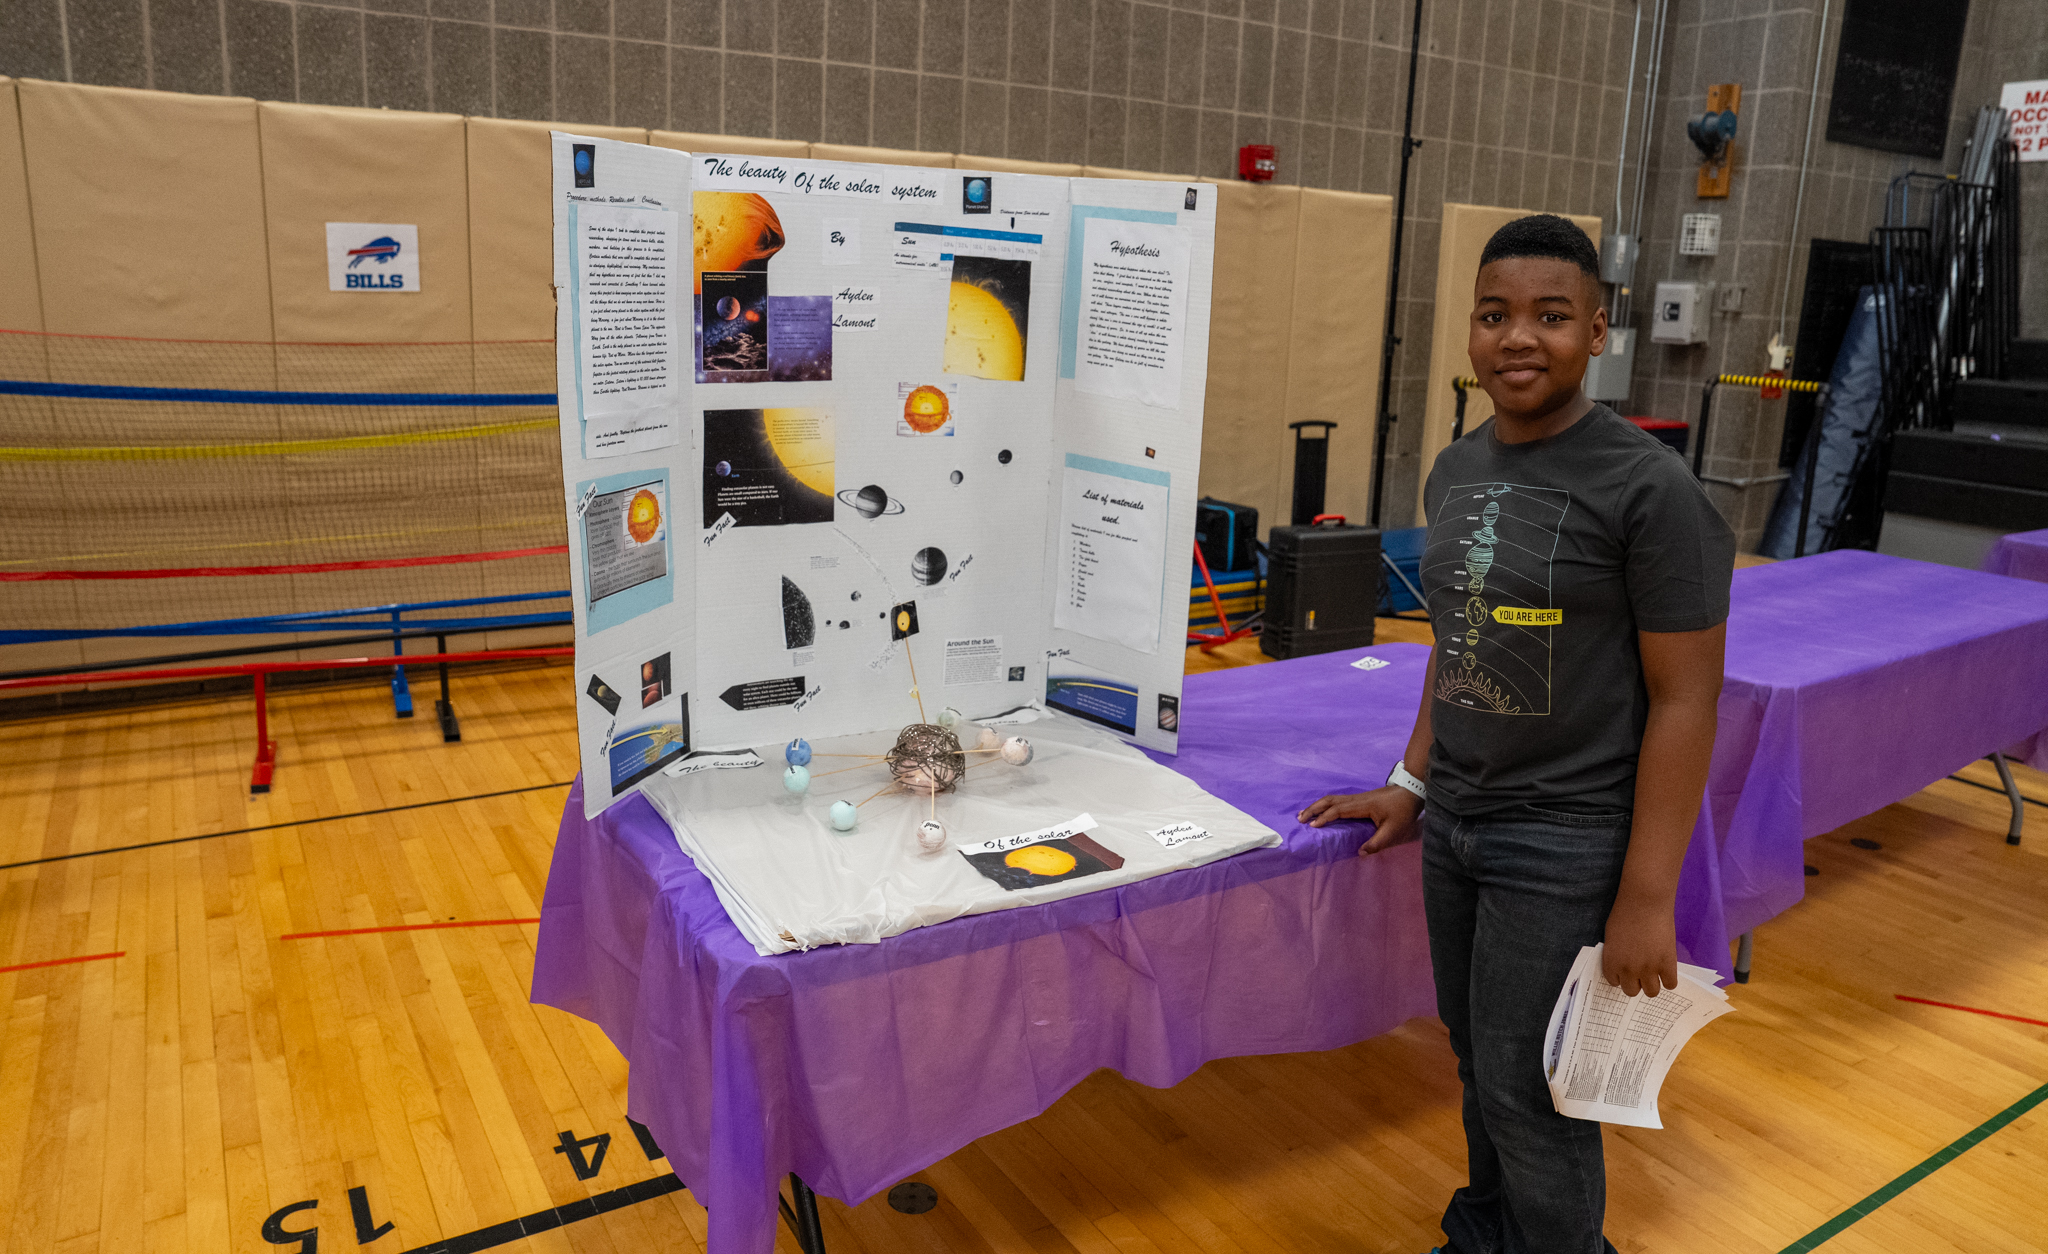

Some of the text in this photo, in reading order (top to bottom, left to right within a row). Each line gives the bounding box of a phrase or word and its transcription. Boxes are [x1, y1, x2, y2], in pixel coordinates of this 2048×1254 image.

[704, 158, 937, 200] The beauty Of the solar system
[830, 232, 845, 246] By
[901, 237, 916, 245] Sun
[1110, 240, 1160, 258] Hypothesis
[346, 274, 404, 288] BILLS
[836, 288, 874, 303] Ayden
[832, 314, 876, 328] Lamont
[576, 486, 596, 517] Fun Fact
[592, 498, 603, 508] Our
[1082, 489, 1144, 510] List of materials
[1102, 515, 1120, 524] used.
[704, 516, 731, 546] Fun Fact
[950, 554, 973, 582] Fun Fact
[1500, 610, 1558, 622] YOU ARE HERE
[1046, 648, 1070, 659] Fun Fact
[794, 700, 807, 712] Fun
[806, 686, 821, 701] Fact
[600, 719, 616, 758] Fun Fact
[679, 759, 758, 773] The beauty
[1156, 825, 1193, 837] Ayden
[1165, 831, 1209, 846] Lamont
[984, 830, 1073, 850] Of the solar
[262, 1185, 395, 1254] 15
